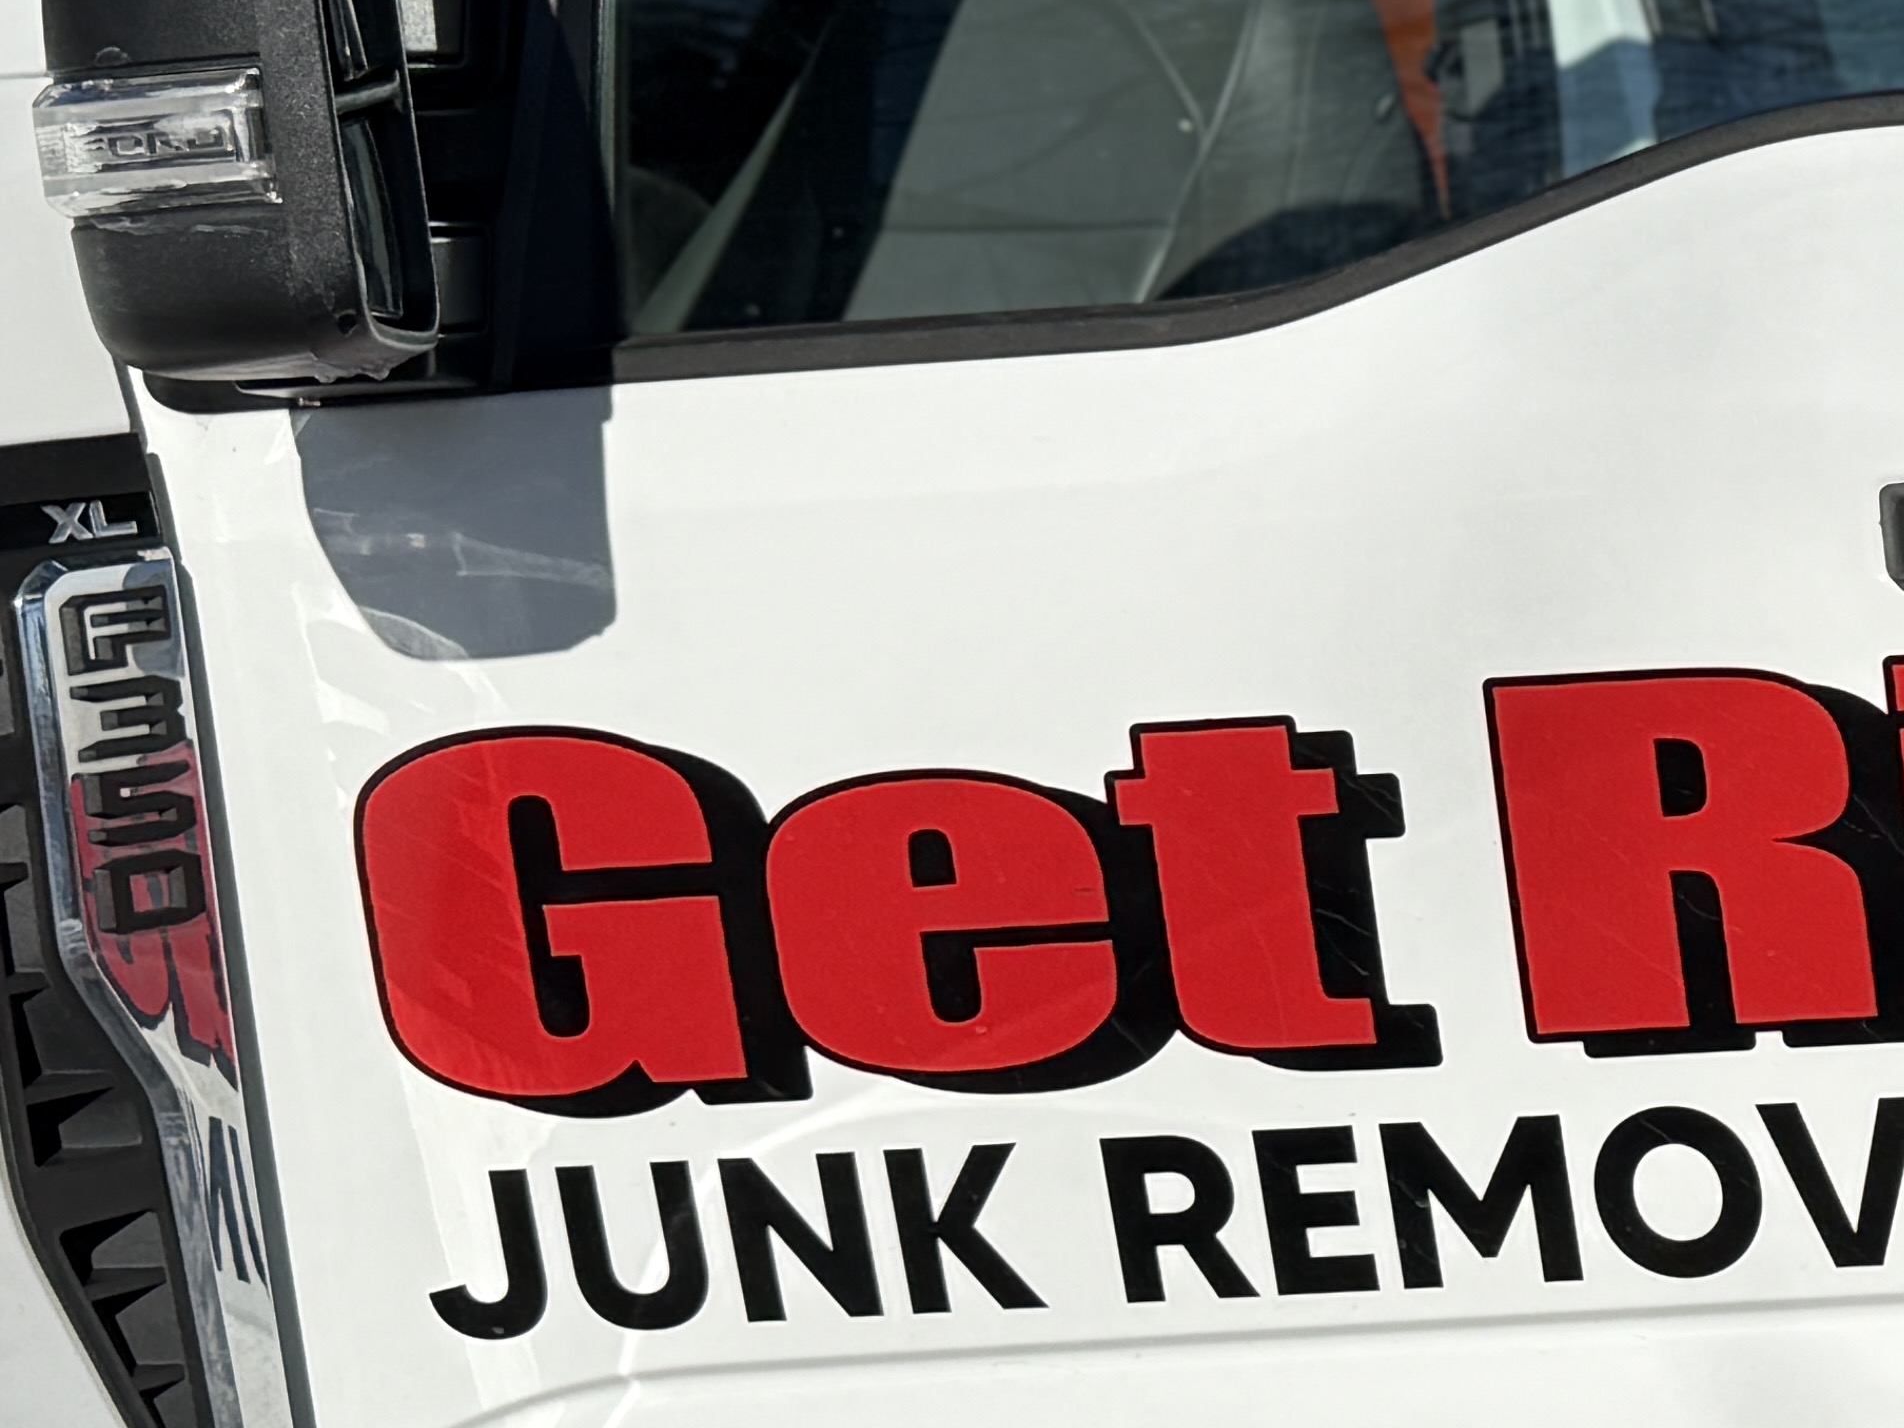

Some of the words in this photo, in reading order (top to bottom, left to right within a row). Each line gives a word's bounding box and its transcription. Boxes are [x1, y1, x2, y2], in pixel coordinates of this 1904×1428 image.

[41, 499, 138, 544] XL
[58, 584, 208, 935] F350
[353, 723, 1444, 1119] Get
[429, 1142, 1051, 1341] JUNK
